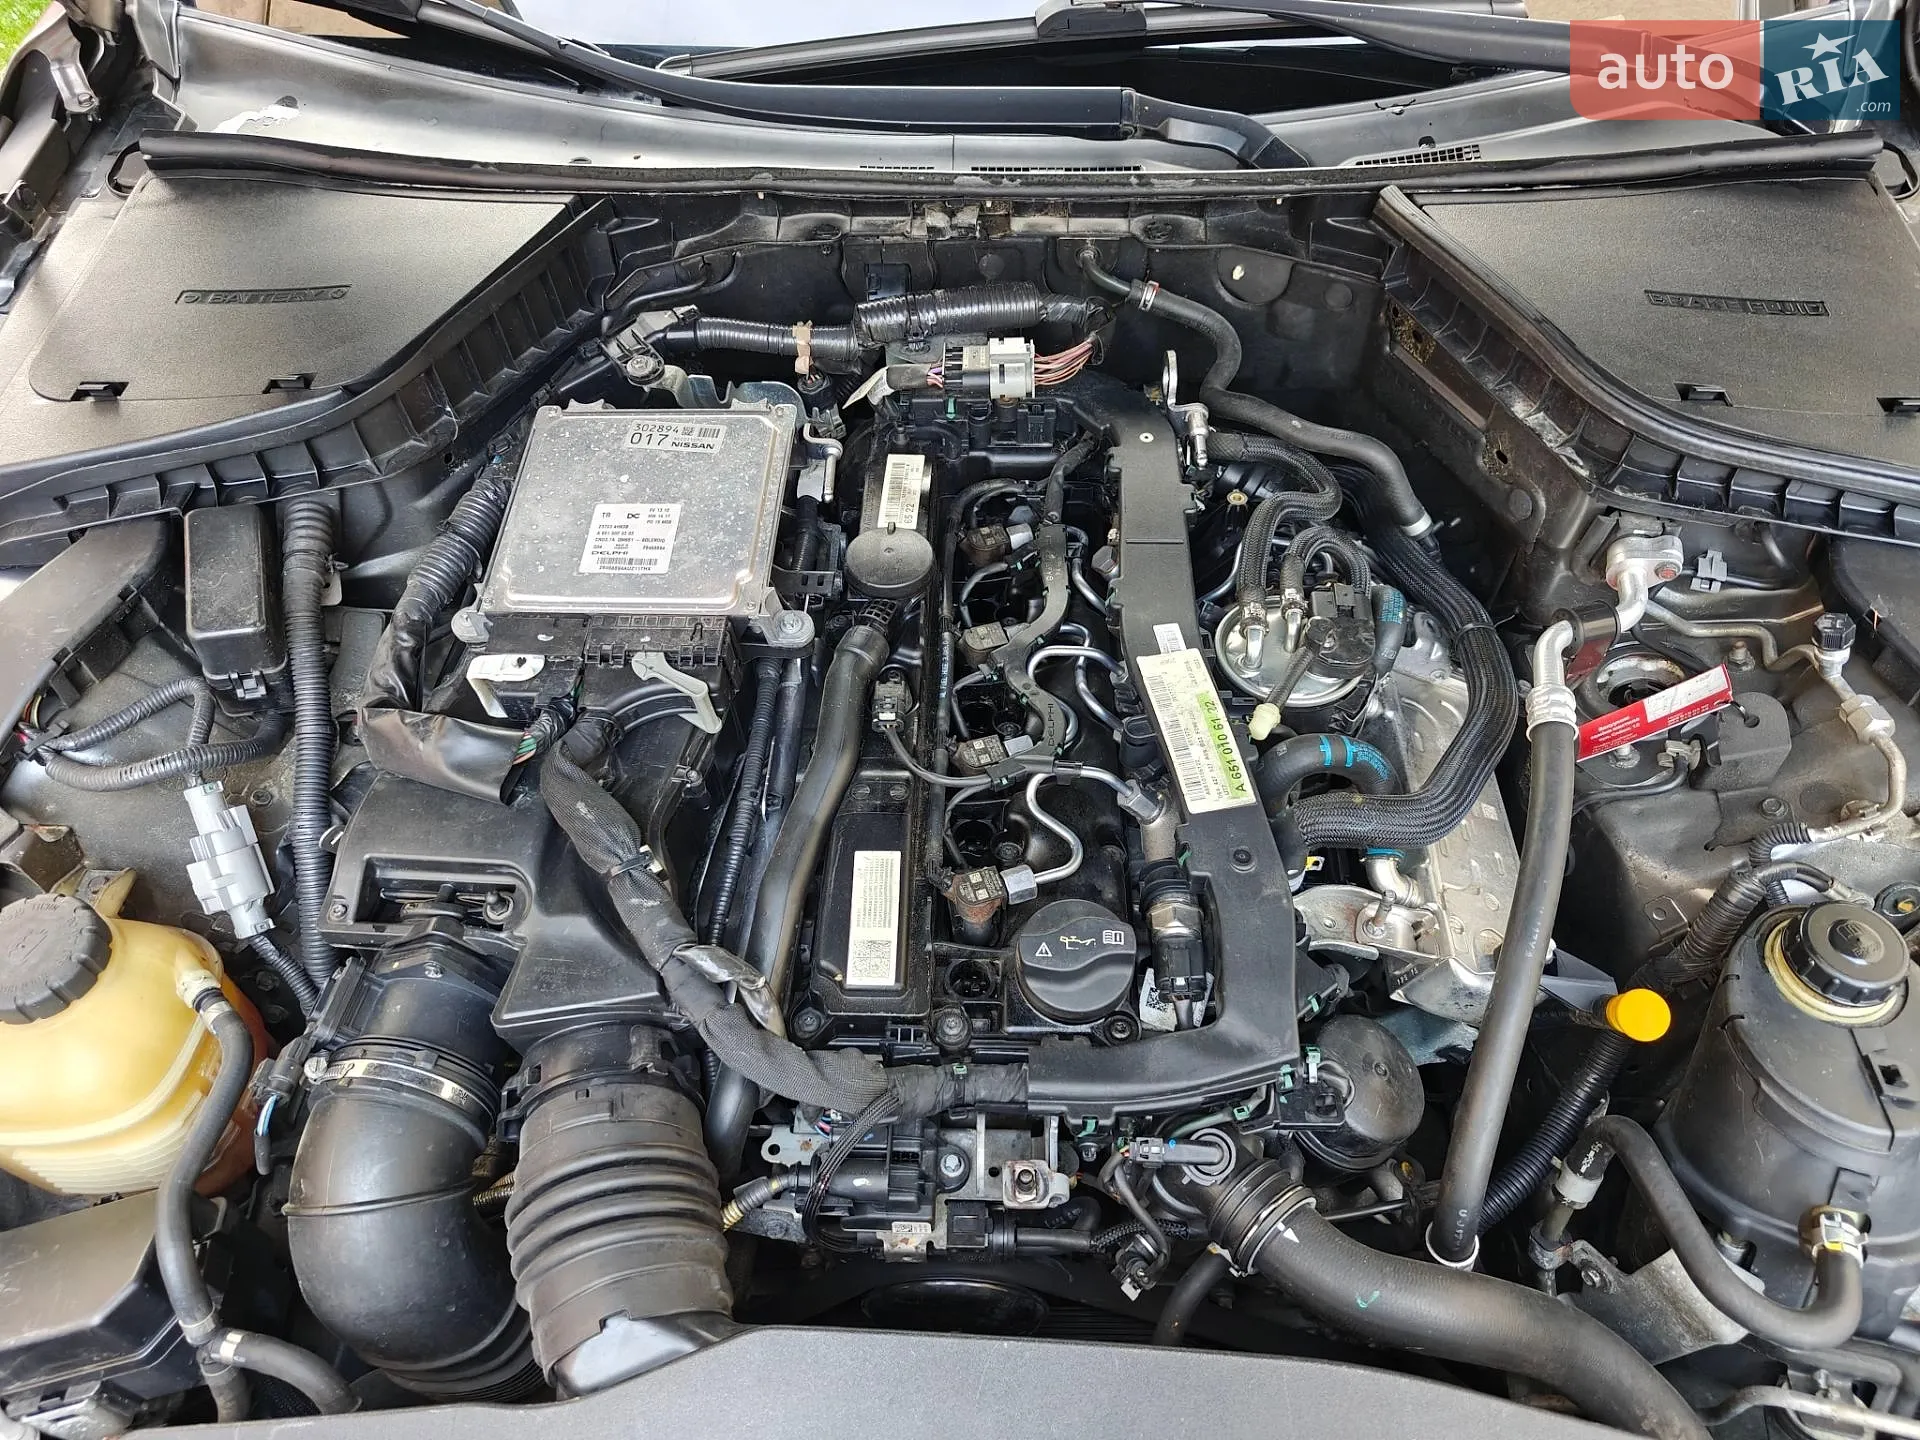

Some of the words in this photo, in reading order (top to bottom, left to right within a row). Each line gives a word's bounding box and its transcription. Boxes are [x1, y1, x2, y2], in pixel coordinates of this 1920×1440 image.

[208, 290, 325, 304] BATTERY
[1648, 292, 1741, 312] BRAKE
[1746, 299, 1826, 316] FLUID
[633, 423, 679, 434] 302894
[630, 432, 669, 446] 017
[671, 441, 715, 450] NISSAN
[1047, 703, 1055, 747] DELPHI
[1210, 717, 1224, 731] 61
[1216, 733, 1234, 755] 010
[1225, 758, 1243, 780] 651
[1234, 782, 1247, 793] A
